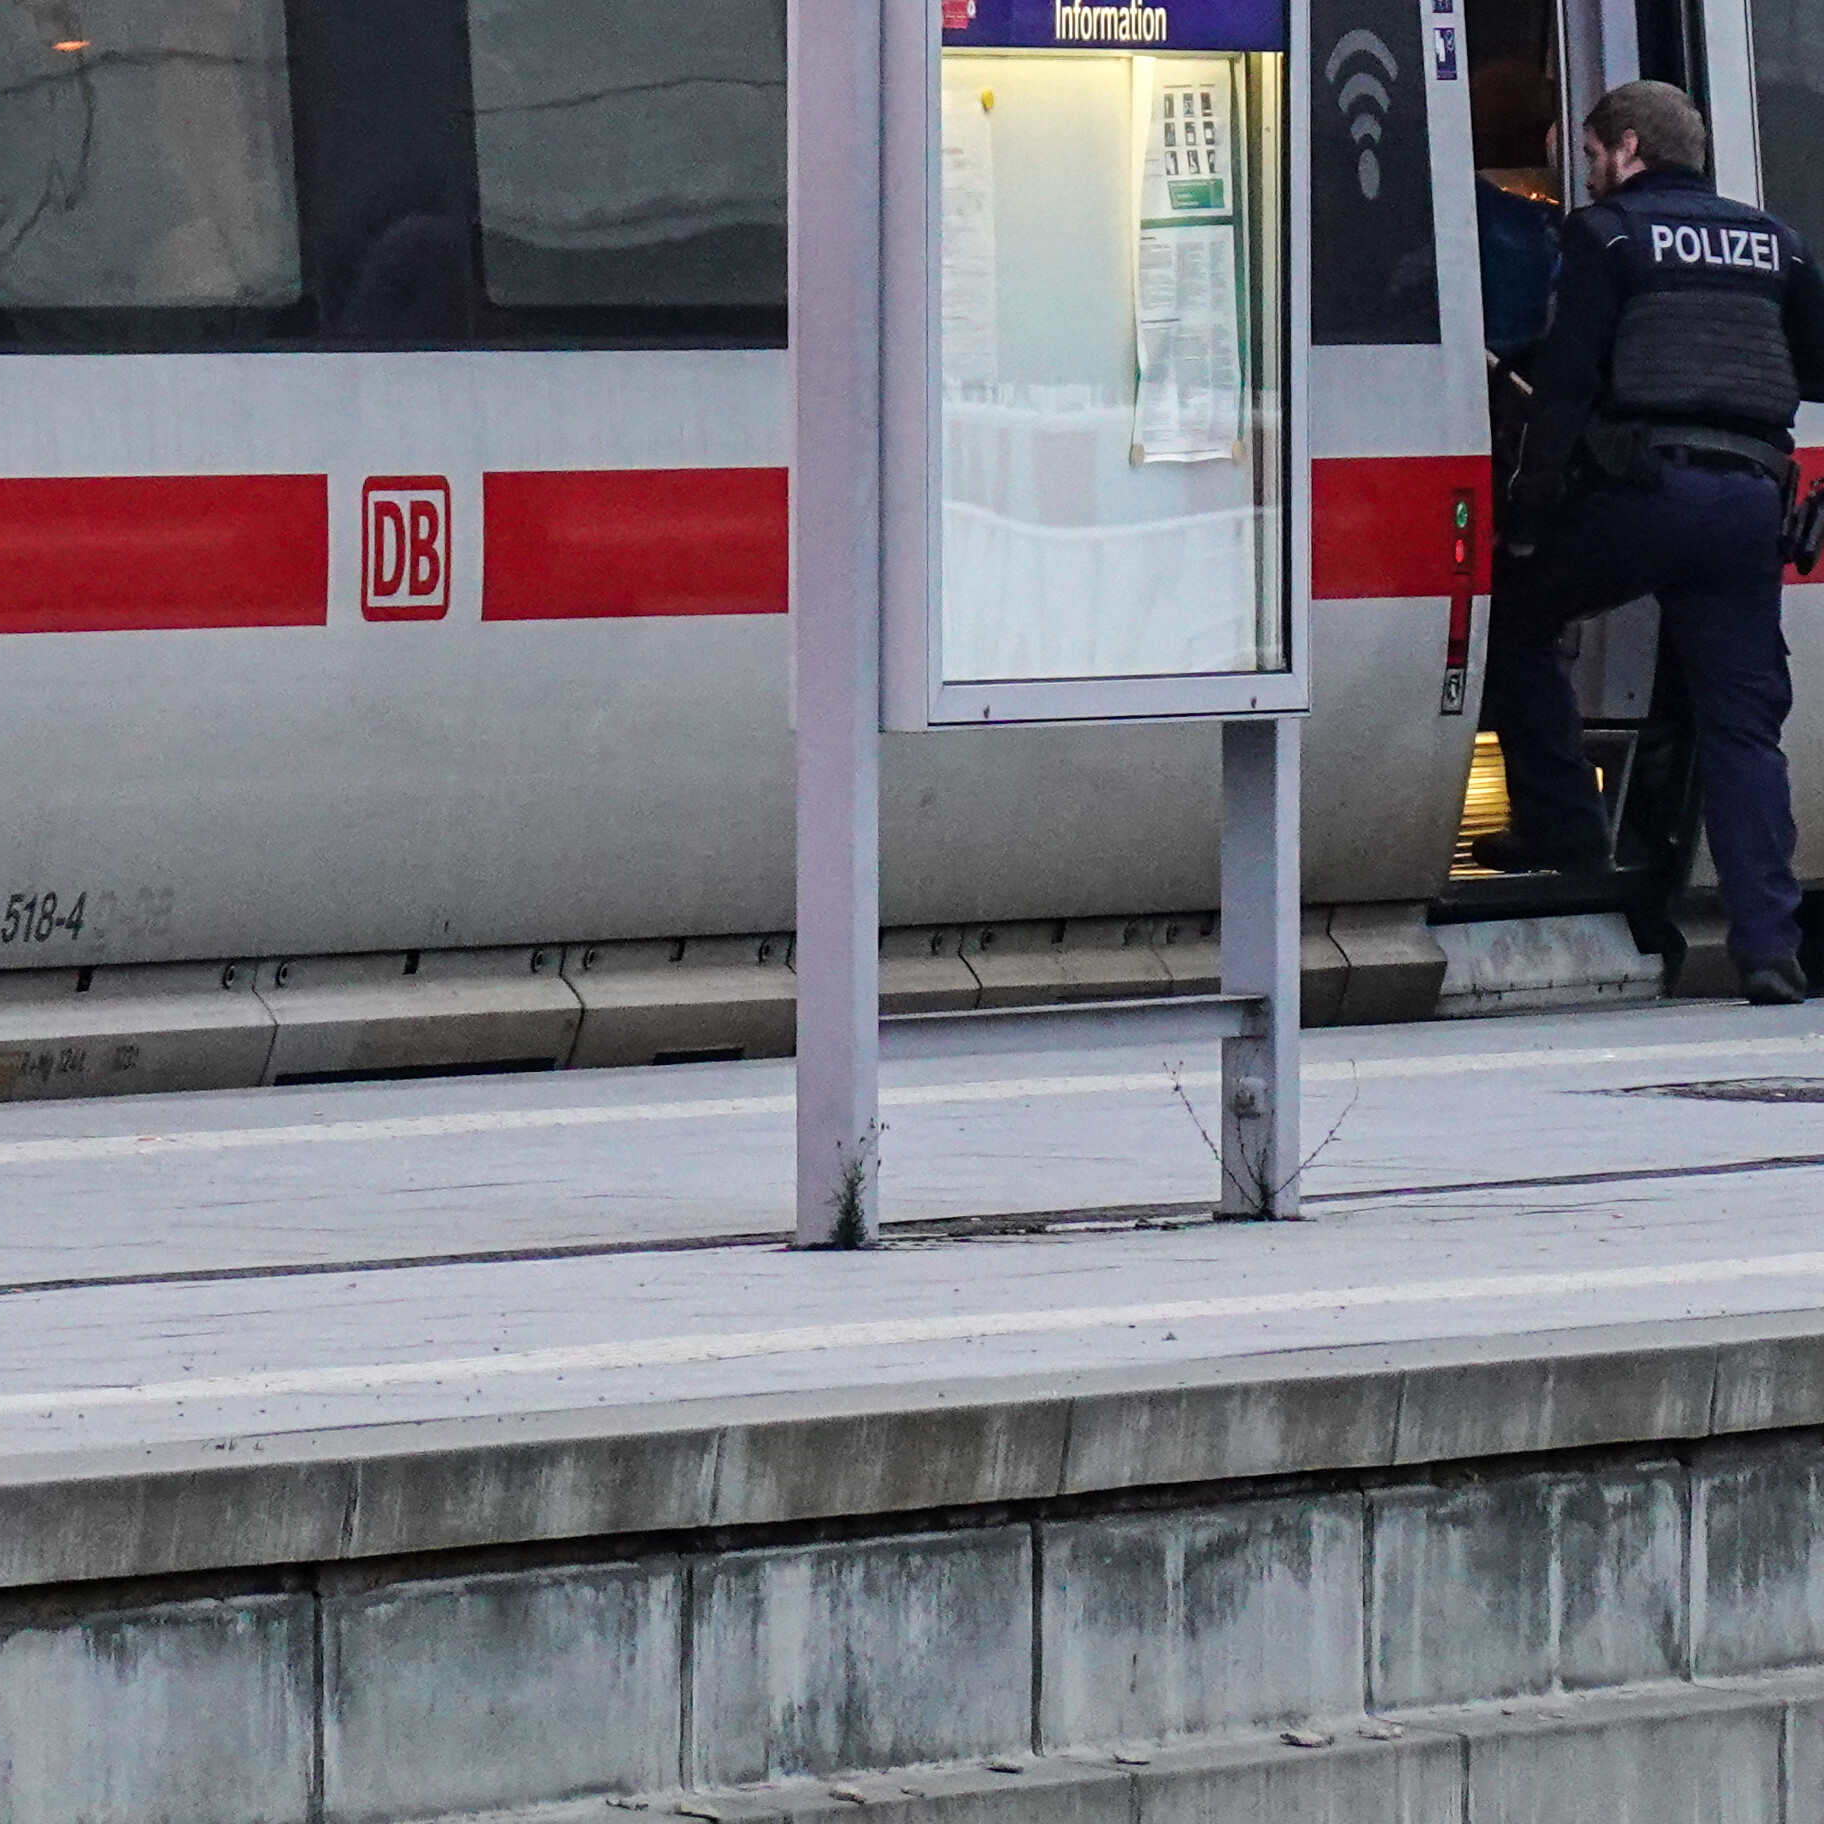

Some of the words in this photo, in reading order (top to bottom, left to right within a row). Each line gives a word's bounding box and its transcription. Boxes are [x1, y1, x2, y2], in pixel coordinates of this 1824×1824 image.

[1651, 224, 1780, 271] POLIZEI
[373, 500, 440, 597] DB
[1, 890, 87, 943] 518-4
